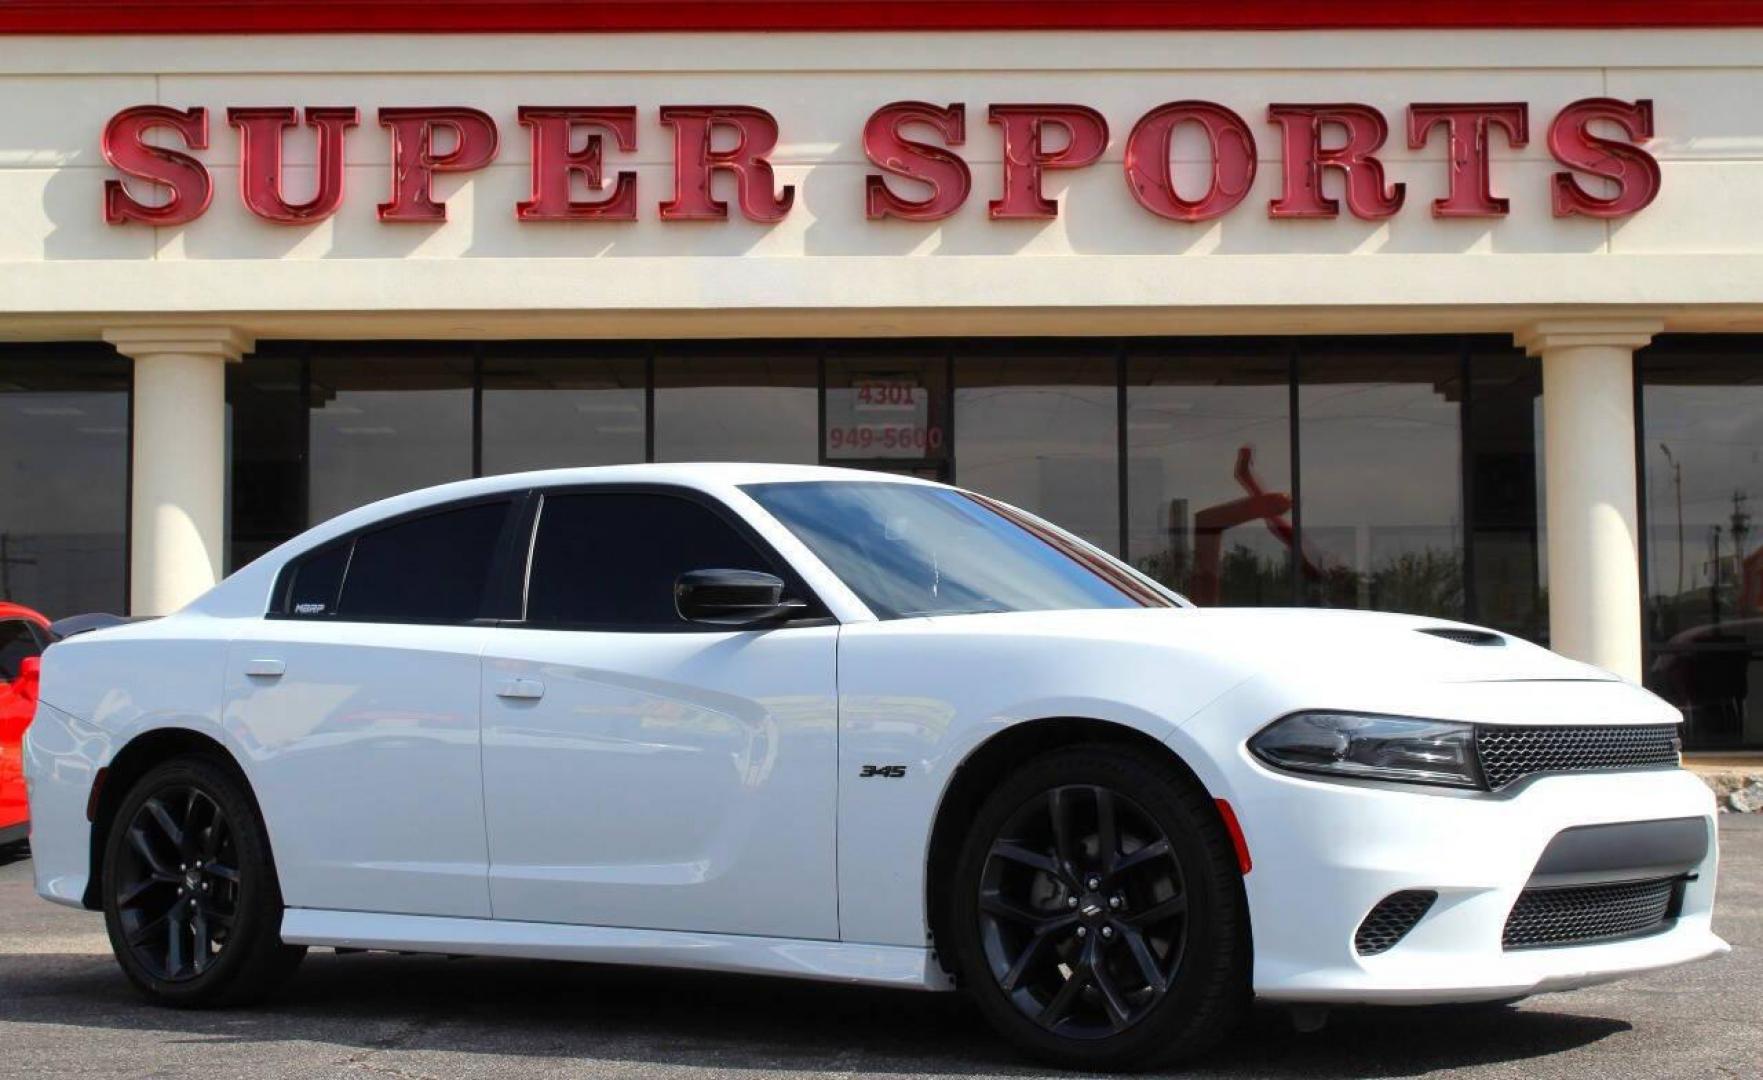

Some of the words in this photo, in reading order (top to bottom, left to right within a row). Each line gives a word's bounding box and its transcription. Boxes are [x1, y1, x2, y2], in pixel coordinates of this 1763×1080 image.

[102, 105, 795, 226] SUPER
[863, 98, 1661, 222] SPORTS
[858, 380, 915, 405] 4301
[830, 426, 944, 449] 949-5600
[859, 765, 907, 778] 345
